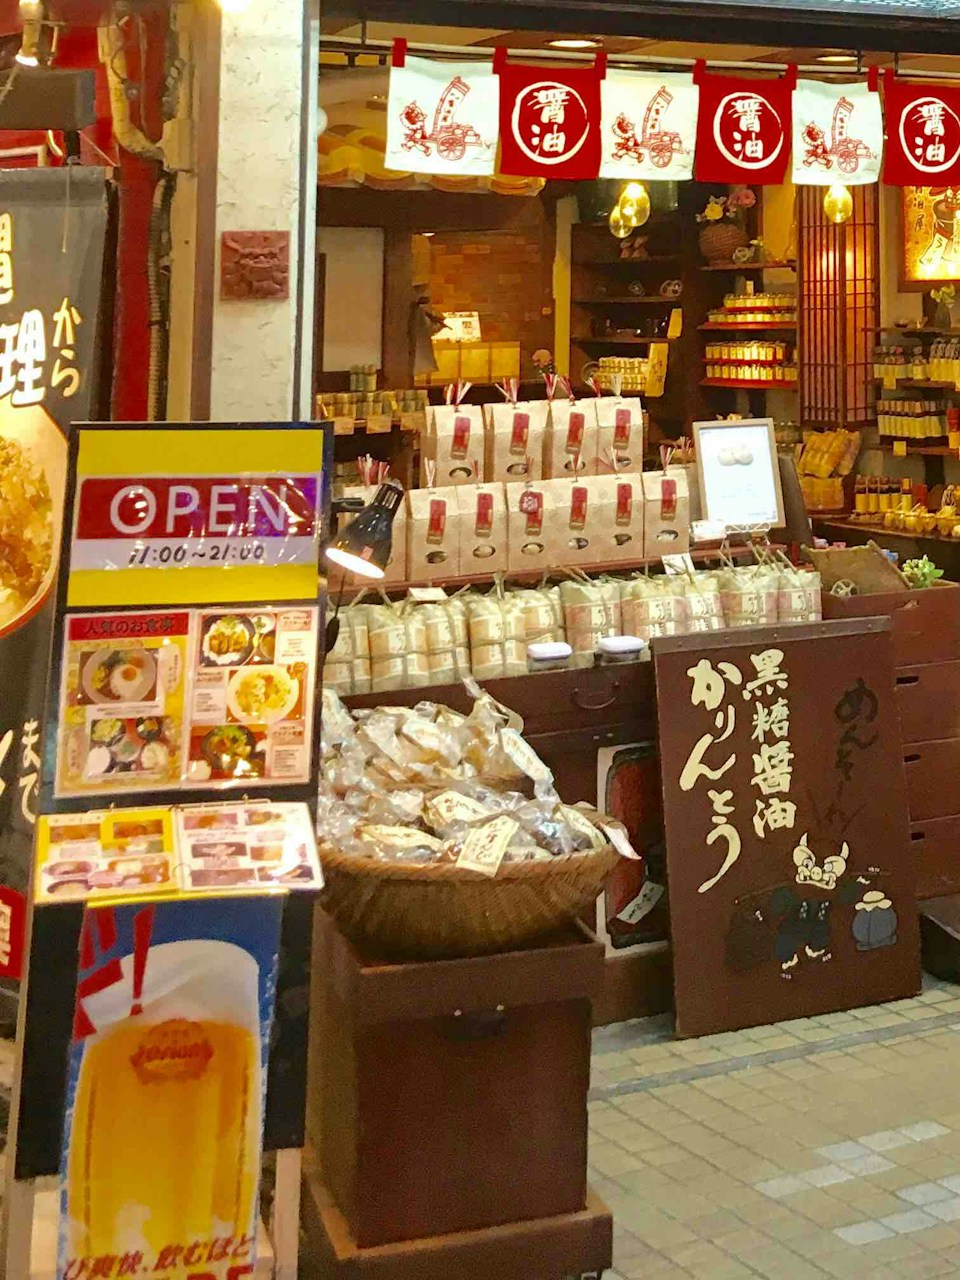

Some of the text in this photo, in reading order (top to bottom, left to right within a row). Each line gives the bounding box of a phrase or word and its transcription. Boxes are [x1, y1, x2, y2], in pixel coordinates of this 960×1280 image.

[527, 87, 570, 157] 醤油
[727, 98, 764, 162] 醤油
[911, 103, 946, 166] 醤油
[51, 296, 83, 398] から
[109, 484, 288, 535] OPEN
[679, 658, 744, 894] かりんとう
[741, 648, 797, 839] 黒糖醤油
